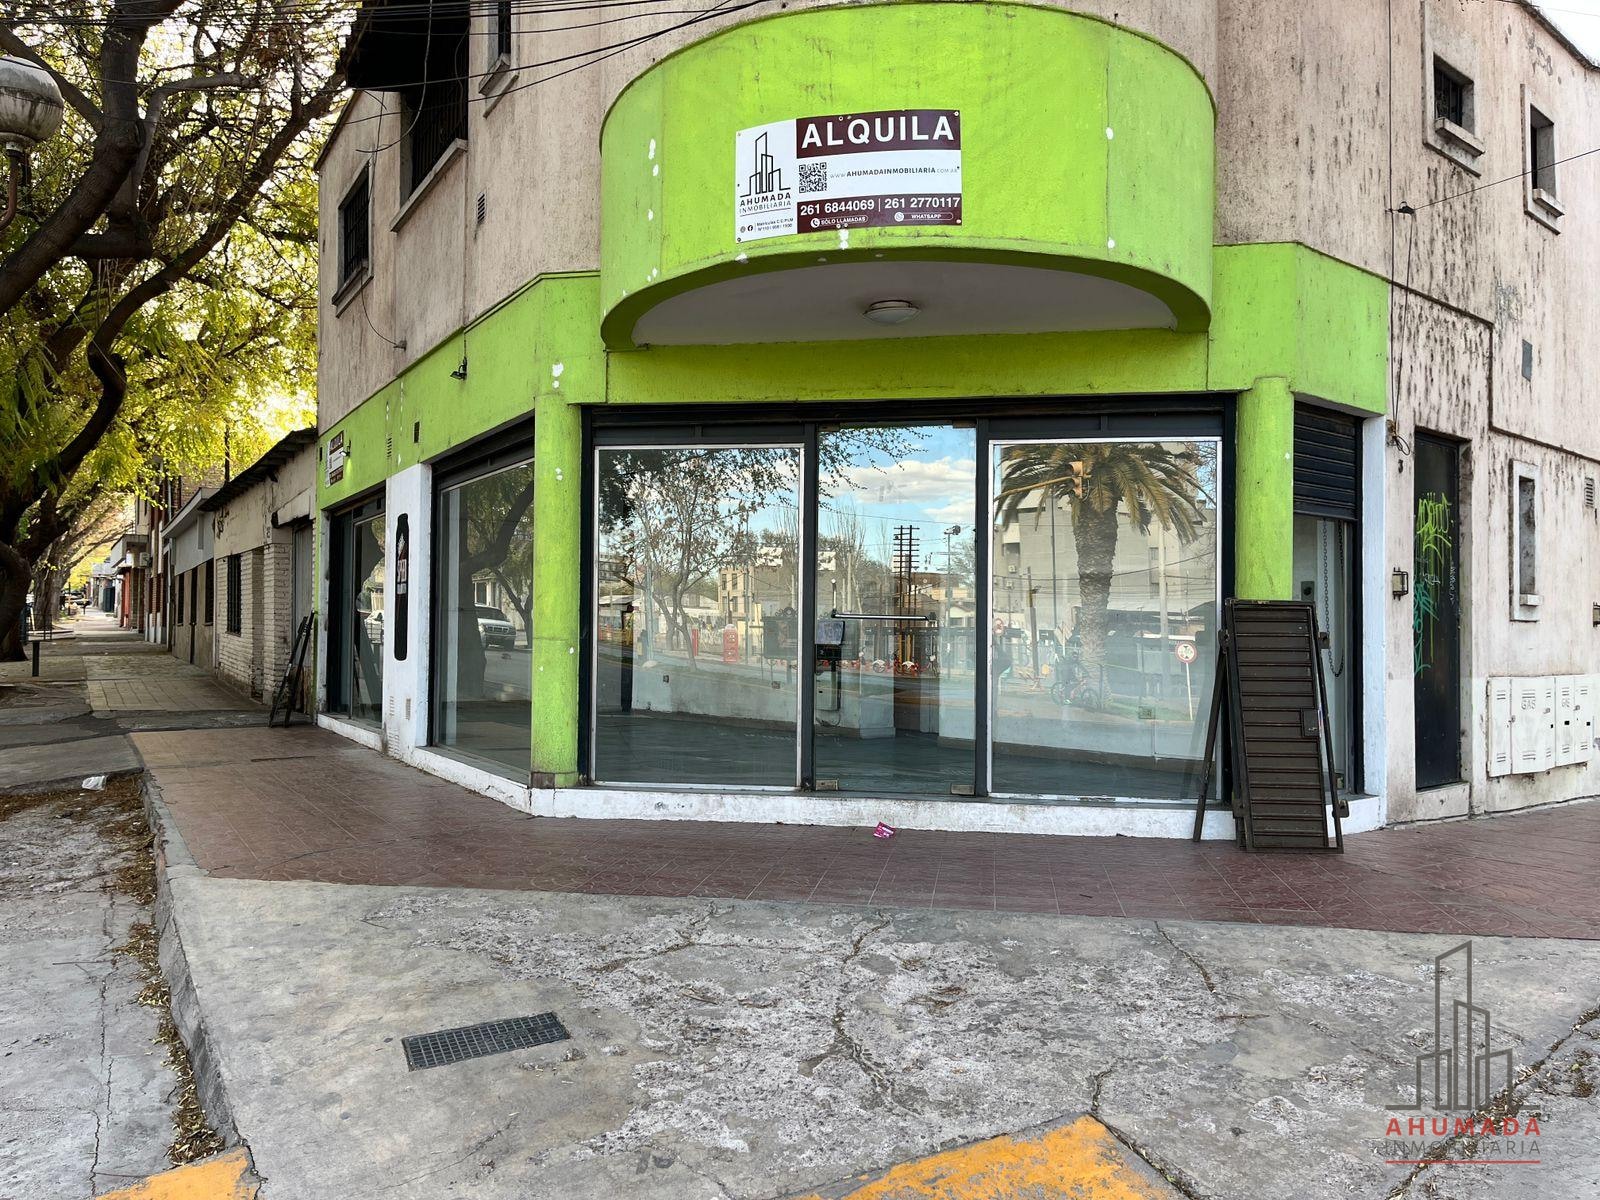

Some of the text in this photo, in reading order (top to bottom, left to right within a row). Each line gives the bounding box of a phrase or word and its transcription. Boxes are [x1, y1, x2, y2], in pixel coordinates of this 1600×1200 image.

[801, 115, 954, 149] ALQUILA
[740, 192, 791, 206] AHUMADA
[740, 200, 791, 214] INMOBILIARIA
[800, 197, 961, 216] 261 6844069 261 2770117
[836, 215, 866, 225] LLAMADAS
